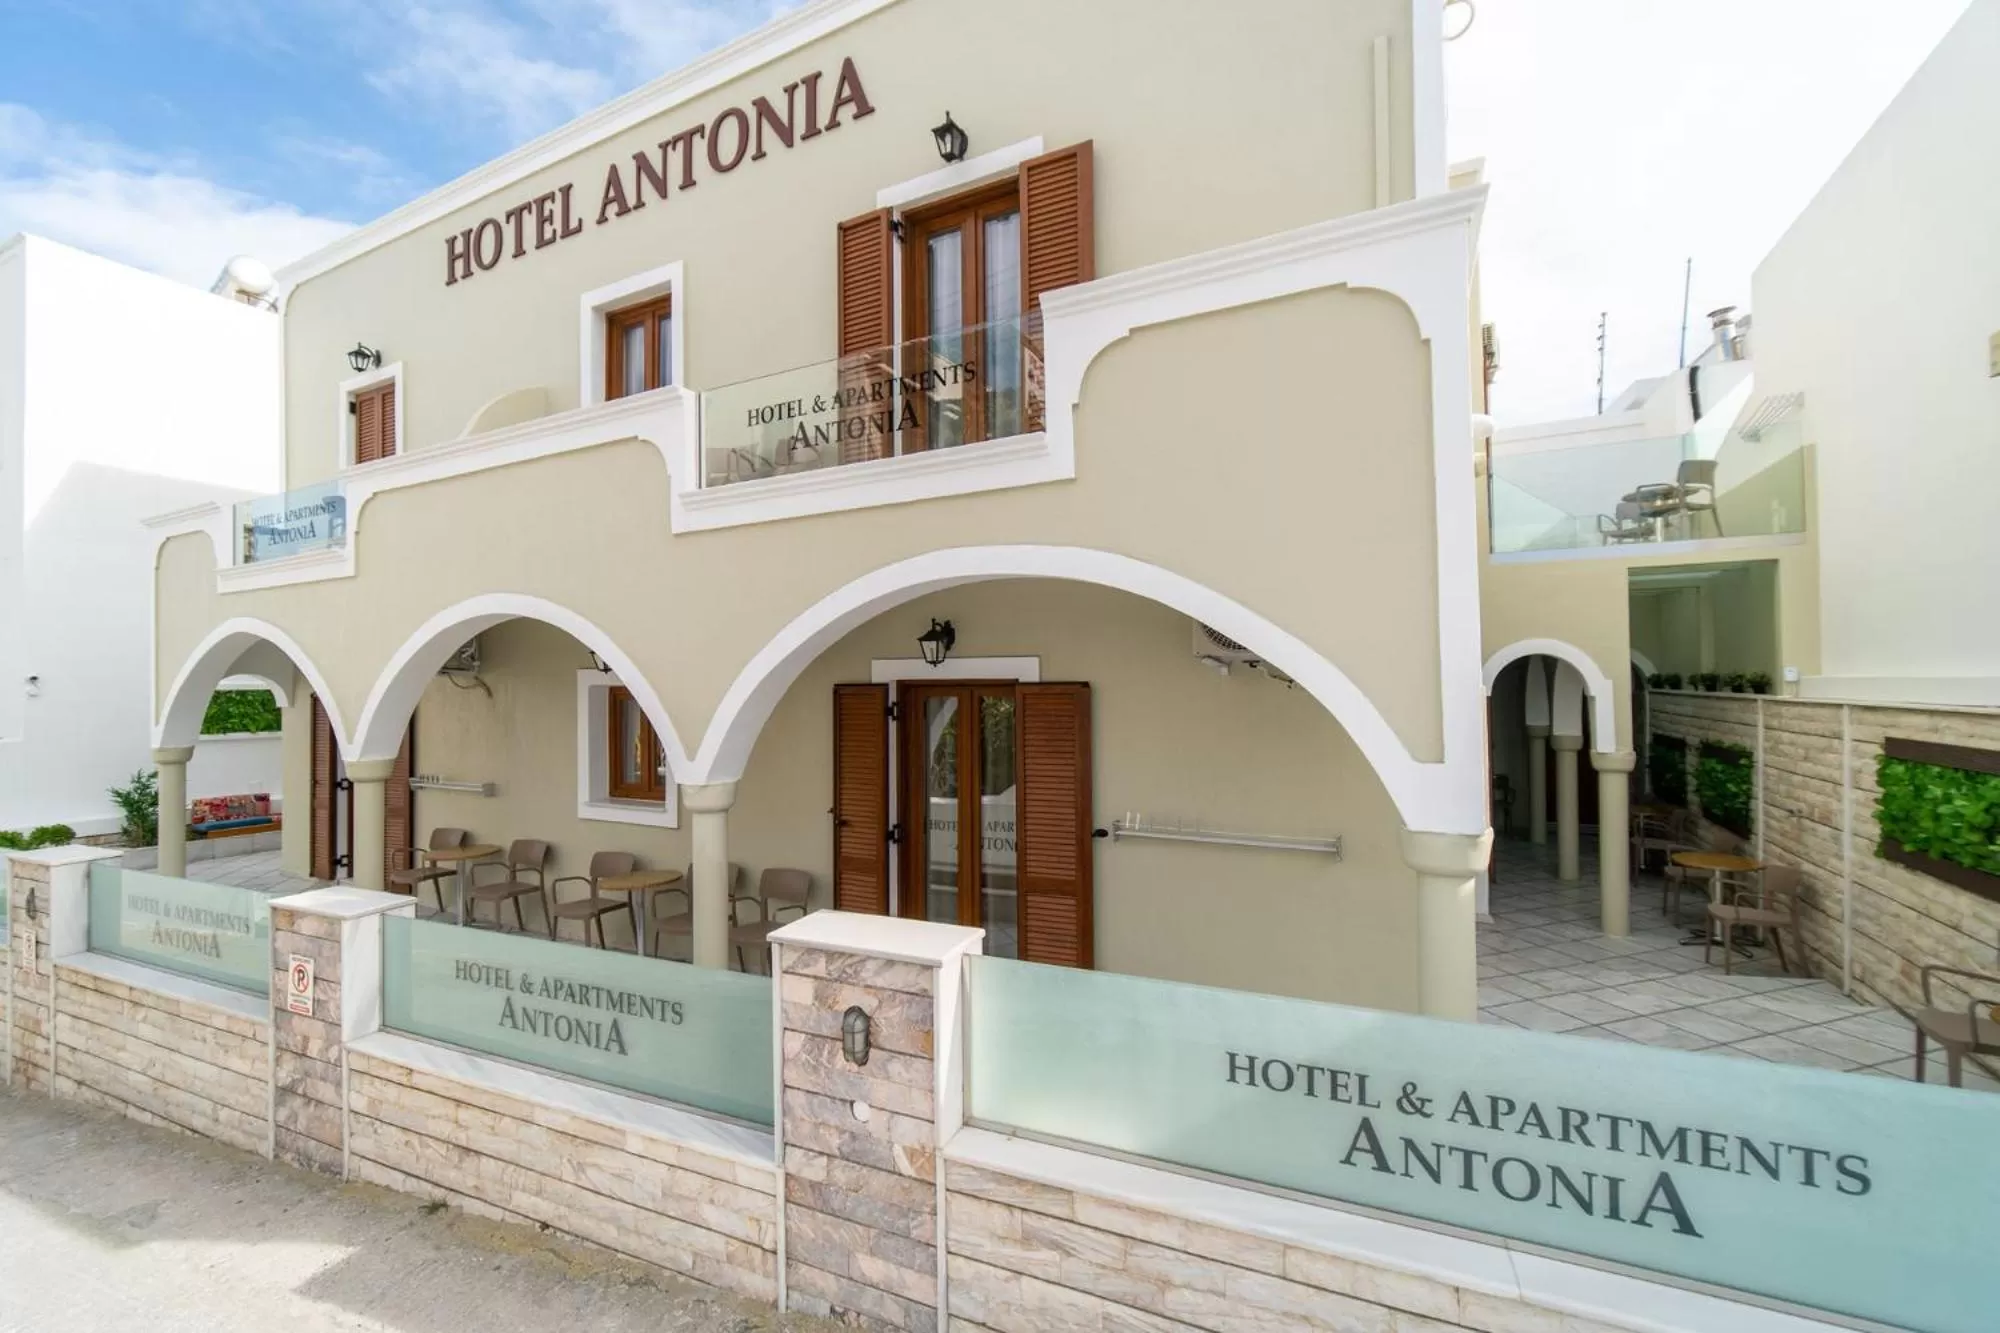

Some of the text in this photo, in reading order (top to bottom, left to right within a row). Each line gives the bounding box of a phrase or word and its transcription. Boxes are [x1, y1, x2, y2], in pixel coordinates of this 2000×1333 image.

[445, 56, 876, 287] HOTEL ANTONIA
[747, 361, 976, 427] HOTEL & APARTMENTS
[791, 399, 921, 450] ANTONIA
[267, 519, 316, 546] ANTONIA
[285, 500, 337, 522] APARTMENTS
[128, 894, 160, 916] HOTEL
[175, 904, 250, 935] APARTMENTS
[151, 918, 222, 959] ANTONIA
[455, 959, 684, 1026] HOTEL & APARTMENTS
[498, 995, 629, 1056] ANTONIA
[1226, 1051, 1873, 1197] HOTEL & APARTMENTS
[1339, 1116, 1704, 1239] ANTONIA
